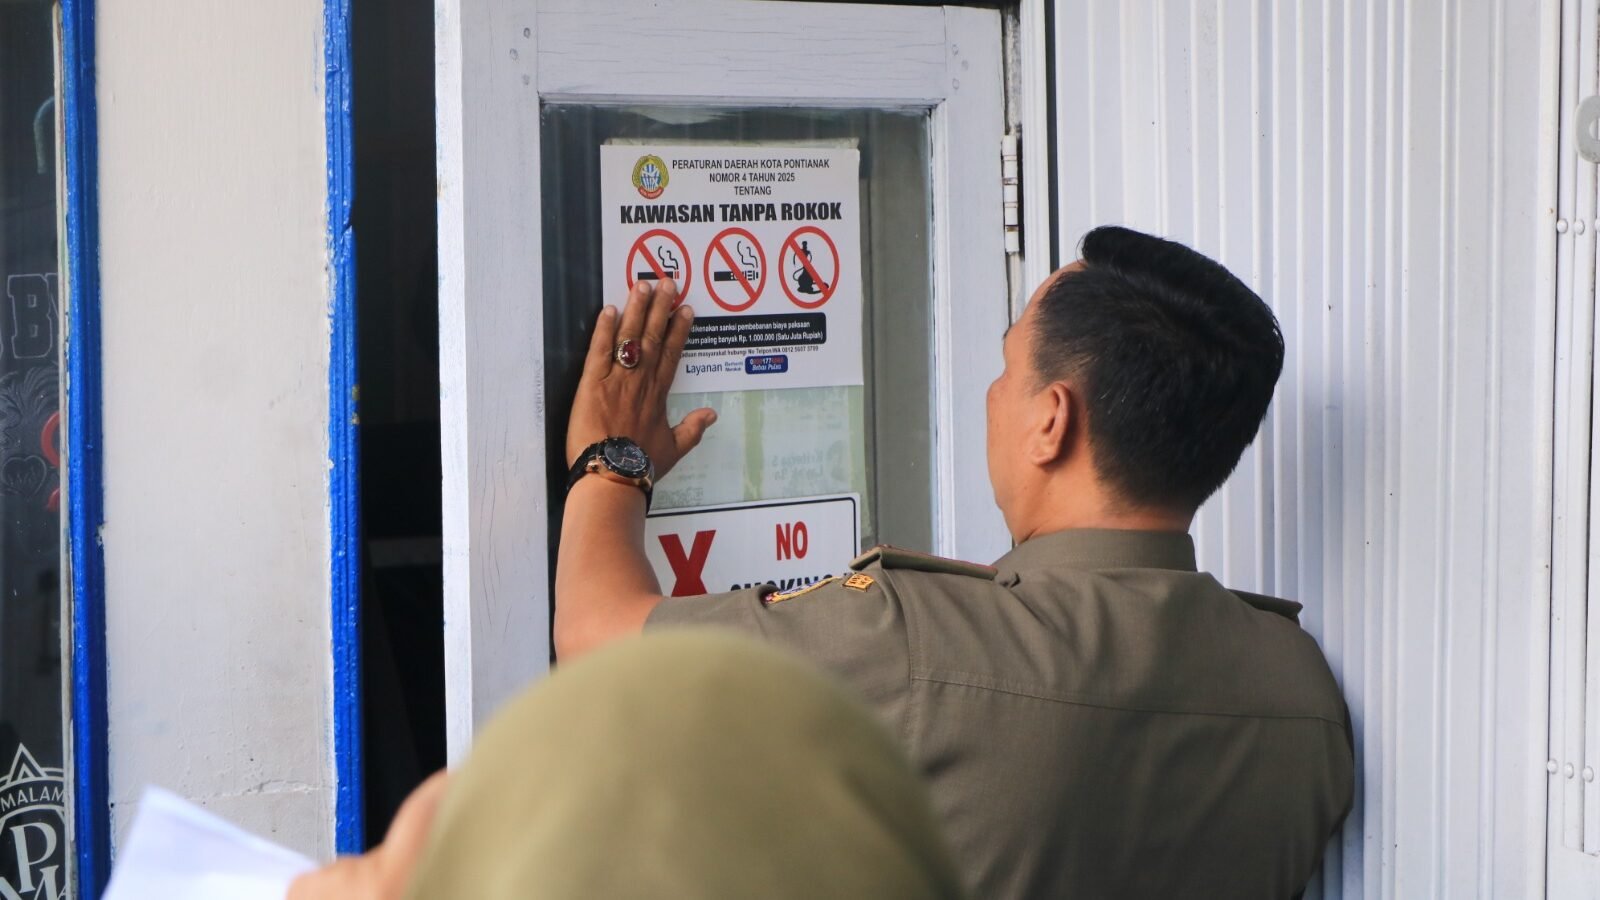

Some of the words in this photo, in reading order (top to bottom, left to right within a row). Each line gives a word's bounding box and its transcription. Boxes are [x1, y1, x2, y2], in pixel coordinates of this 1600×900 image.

[672, 159, 722, 170] PERATURAN
[724, 159, 759, 169] DAERAH
[760, 159, 783, 169] KOTA
[784, 158, 830, 169] PONTIANAK
[709, 172, 740, 183] NOMOR
[741, 172, 747, 182] 4
[749, 172, 776, 182] TAHUN
[777, 172, 796, 182] 2025
[734, 185, 772, 196] TENTANG
[620, 204, 715, 224] KAWASAN
[719, 203, 778, 222] TANPA
[781, 202, 842, 221] ROKOK
[685, 363, 723, 376] Layanan
[775, 520, 809, 562] NO
